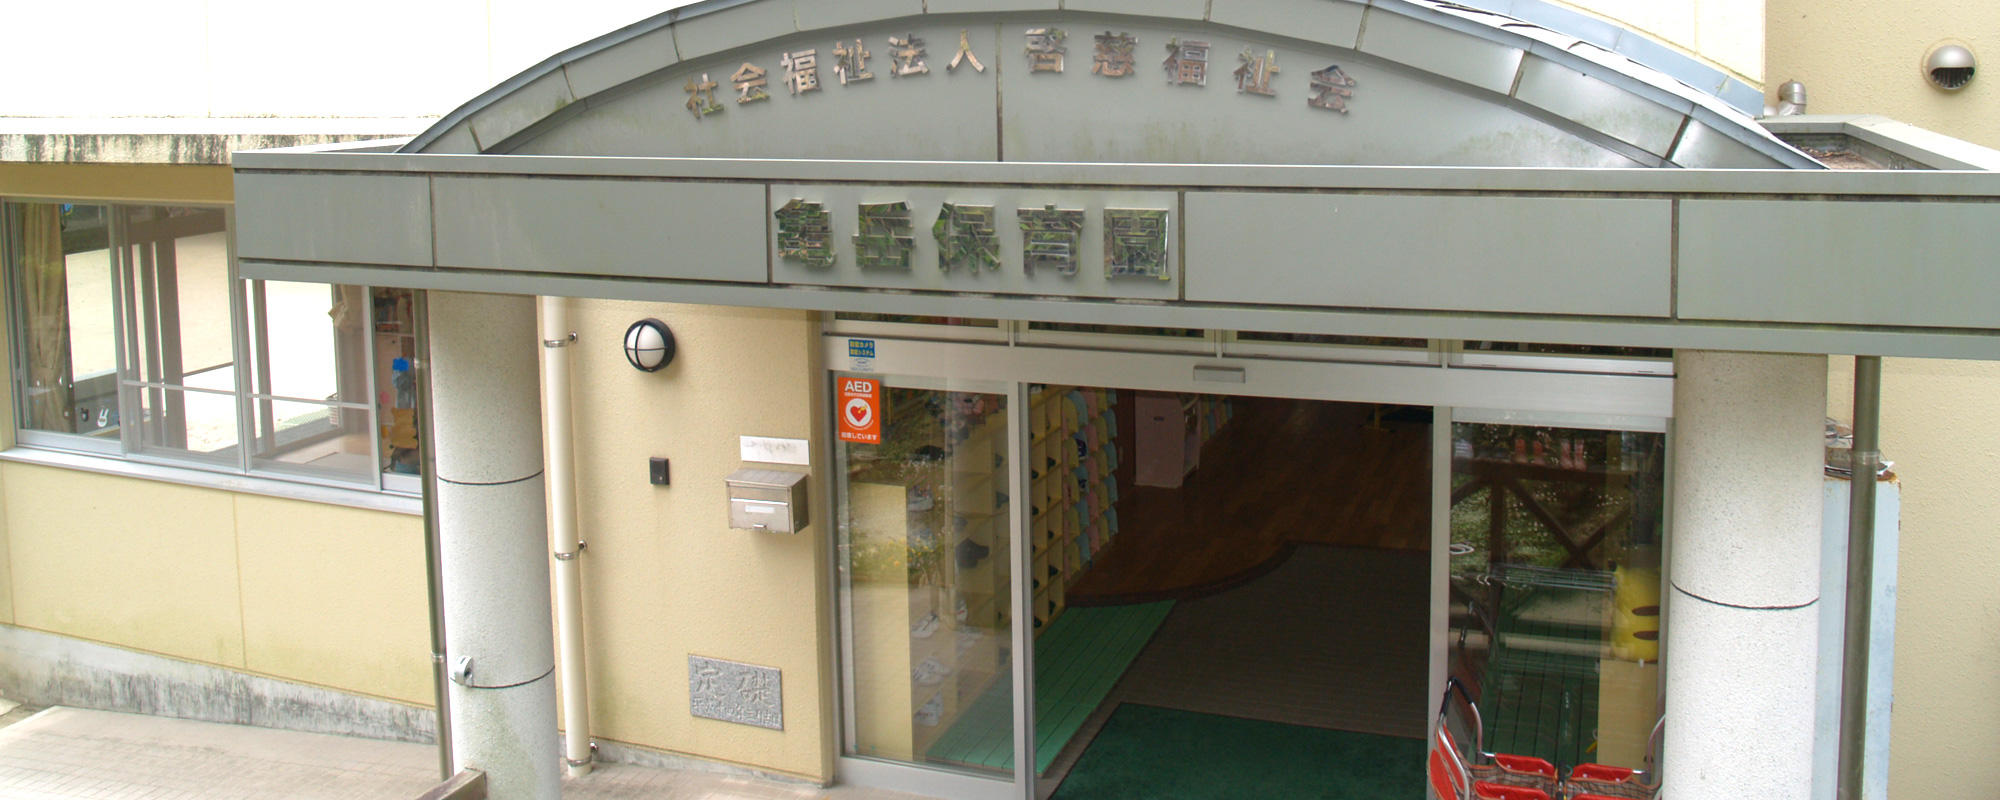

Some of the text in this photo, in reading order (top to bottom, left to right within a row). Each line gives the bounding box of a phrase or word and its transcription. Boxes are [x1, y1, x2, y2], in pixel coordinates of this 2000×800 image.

[684, 27, 1357, 118] 社会福祉法人 啓慈福祉会
[774, 198, 1171, 280] 亀岳保育園
[844, 380, 872, 393] AED
